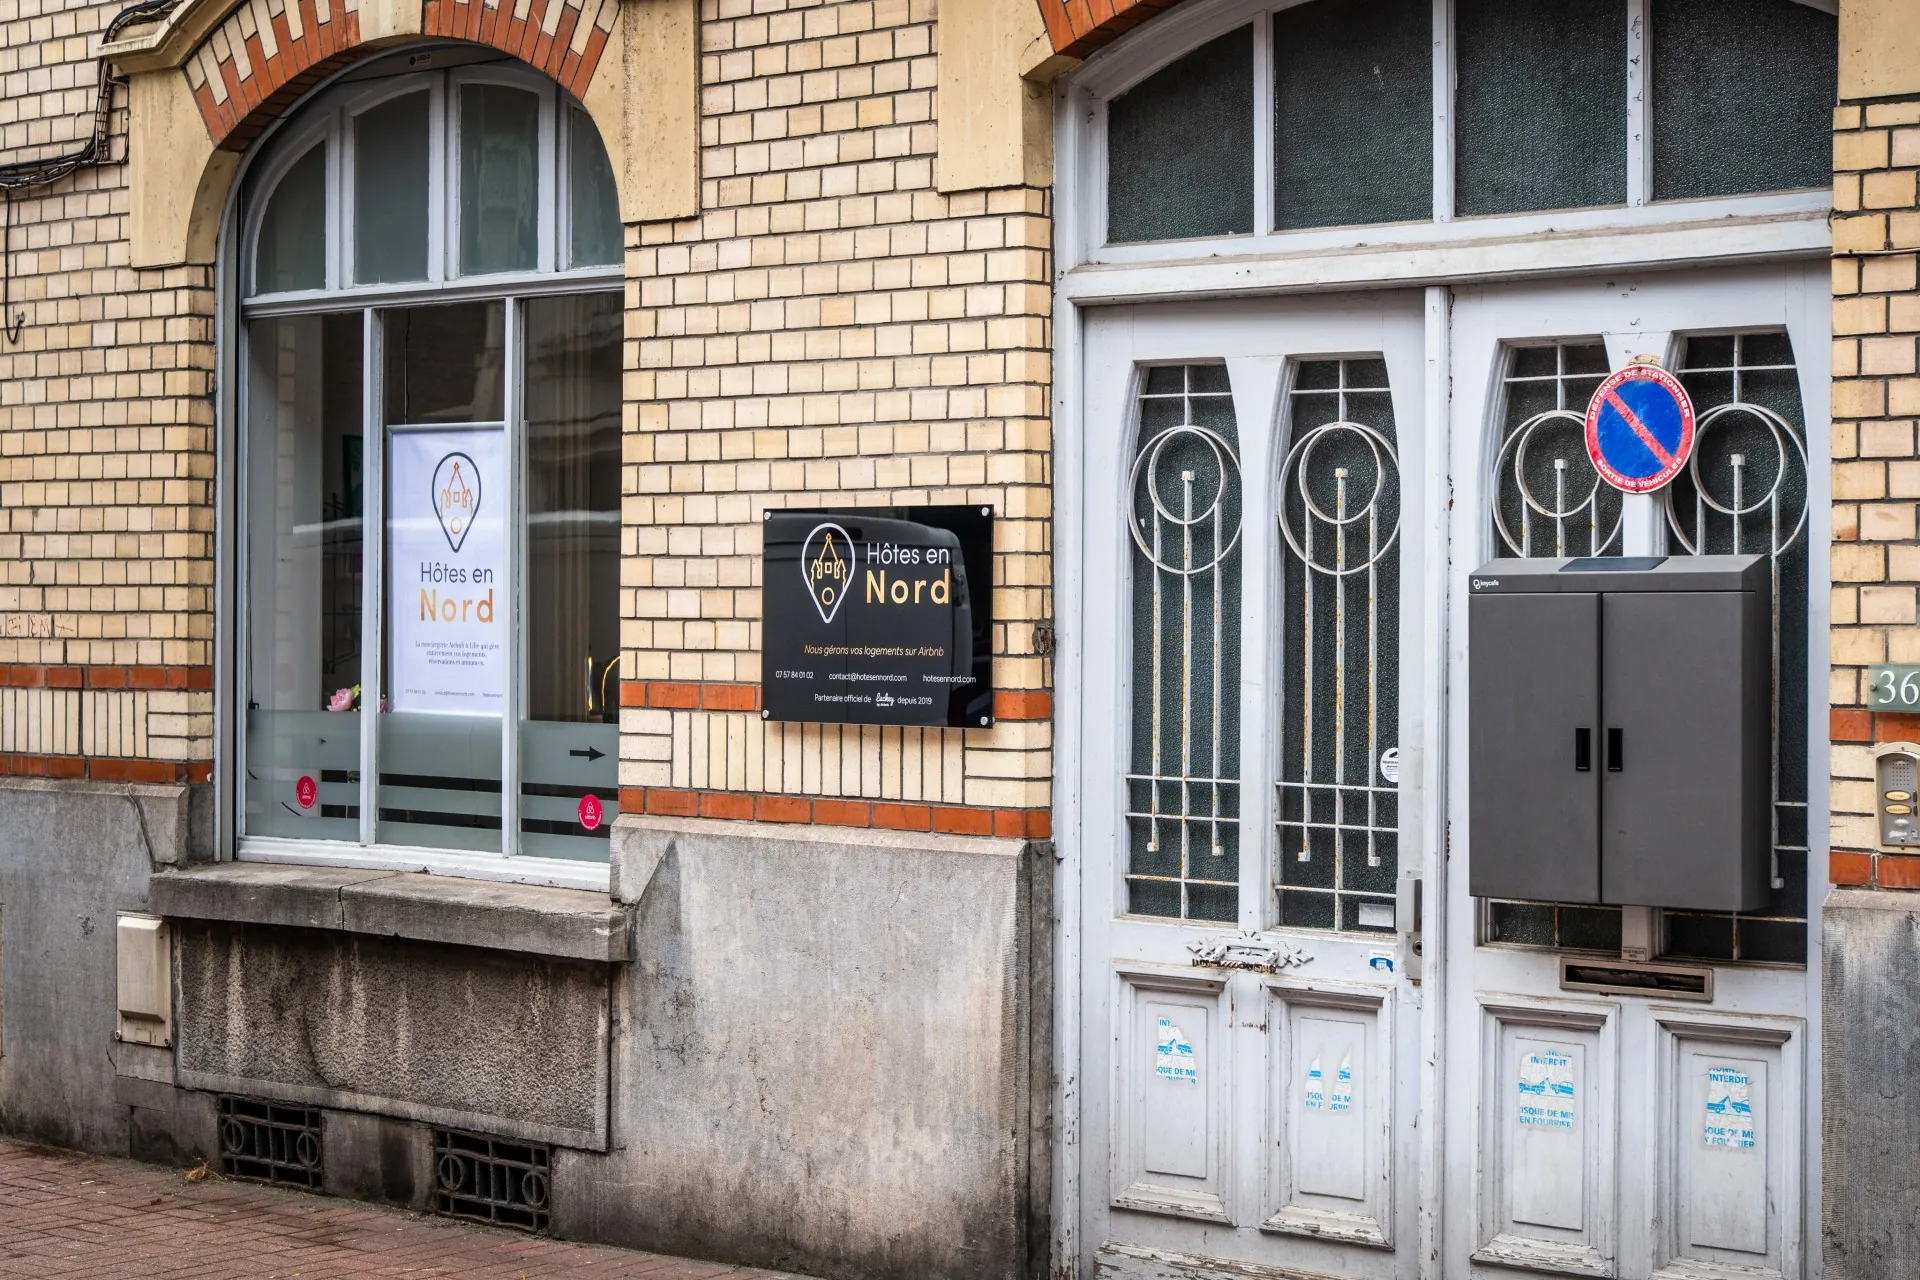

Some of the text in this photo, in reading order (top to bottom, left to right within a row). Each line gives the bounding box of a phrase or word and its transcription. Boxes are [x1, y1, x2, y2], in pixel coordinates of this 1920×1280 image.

[1624, 369, 1638, 378] DE
[1640, 369, 1690, 419] STATIONNER
[1596, 458, 1623, 485] SORTIE
[1624, 479, 1637, 488] DE
[867, 542, 949, 564] Hôtes en
[421, 561, 493, 584] Hôtes en
[866, 568, 950, 604] Nord
[420, 588, 493, 623] Nord
[804, 644, 945, 658] Nous gérons vos logements sur Airbnb
[775, 670, 783, 679] 07
[783, 670, 791, 679] 57
[791, 670, 799, 679] 84
[806, 671, 814, 679] 02
[828, 672, 908, 682] contact@hotesennord.com
[922, 673, 977, 683] hotesennord.com
[1878, 670, 1920, 705] 36
[814, 693, 844, 702] Partenaire
[844, 694, 863, 703] officiel
[863, 695, 872, 703] de
[897, 696, 917, 706] depuis
[917, 696, 933, 705] 2019
[1156, 1065, 1173, 1074] QUE
[1174, 1067, 1184, 1075] DE
[1709, 1073, 1749, 1085] INTERDIT
[1519, 1106, 1545, 1116] ISQUE
[1546, 1108, 1558, 1117] DE
[1519, 1115, 1531, 1124] EN
